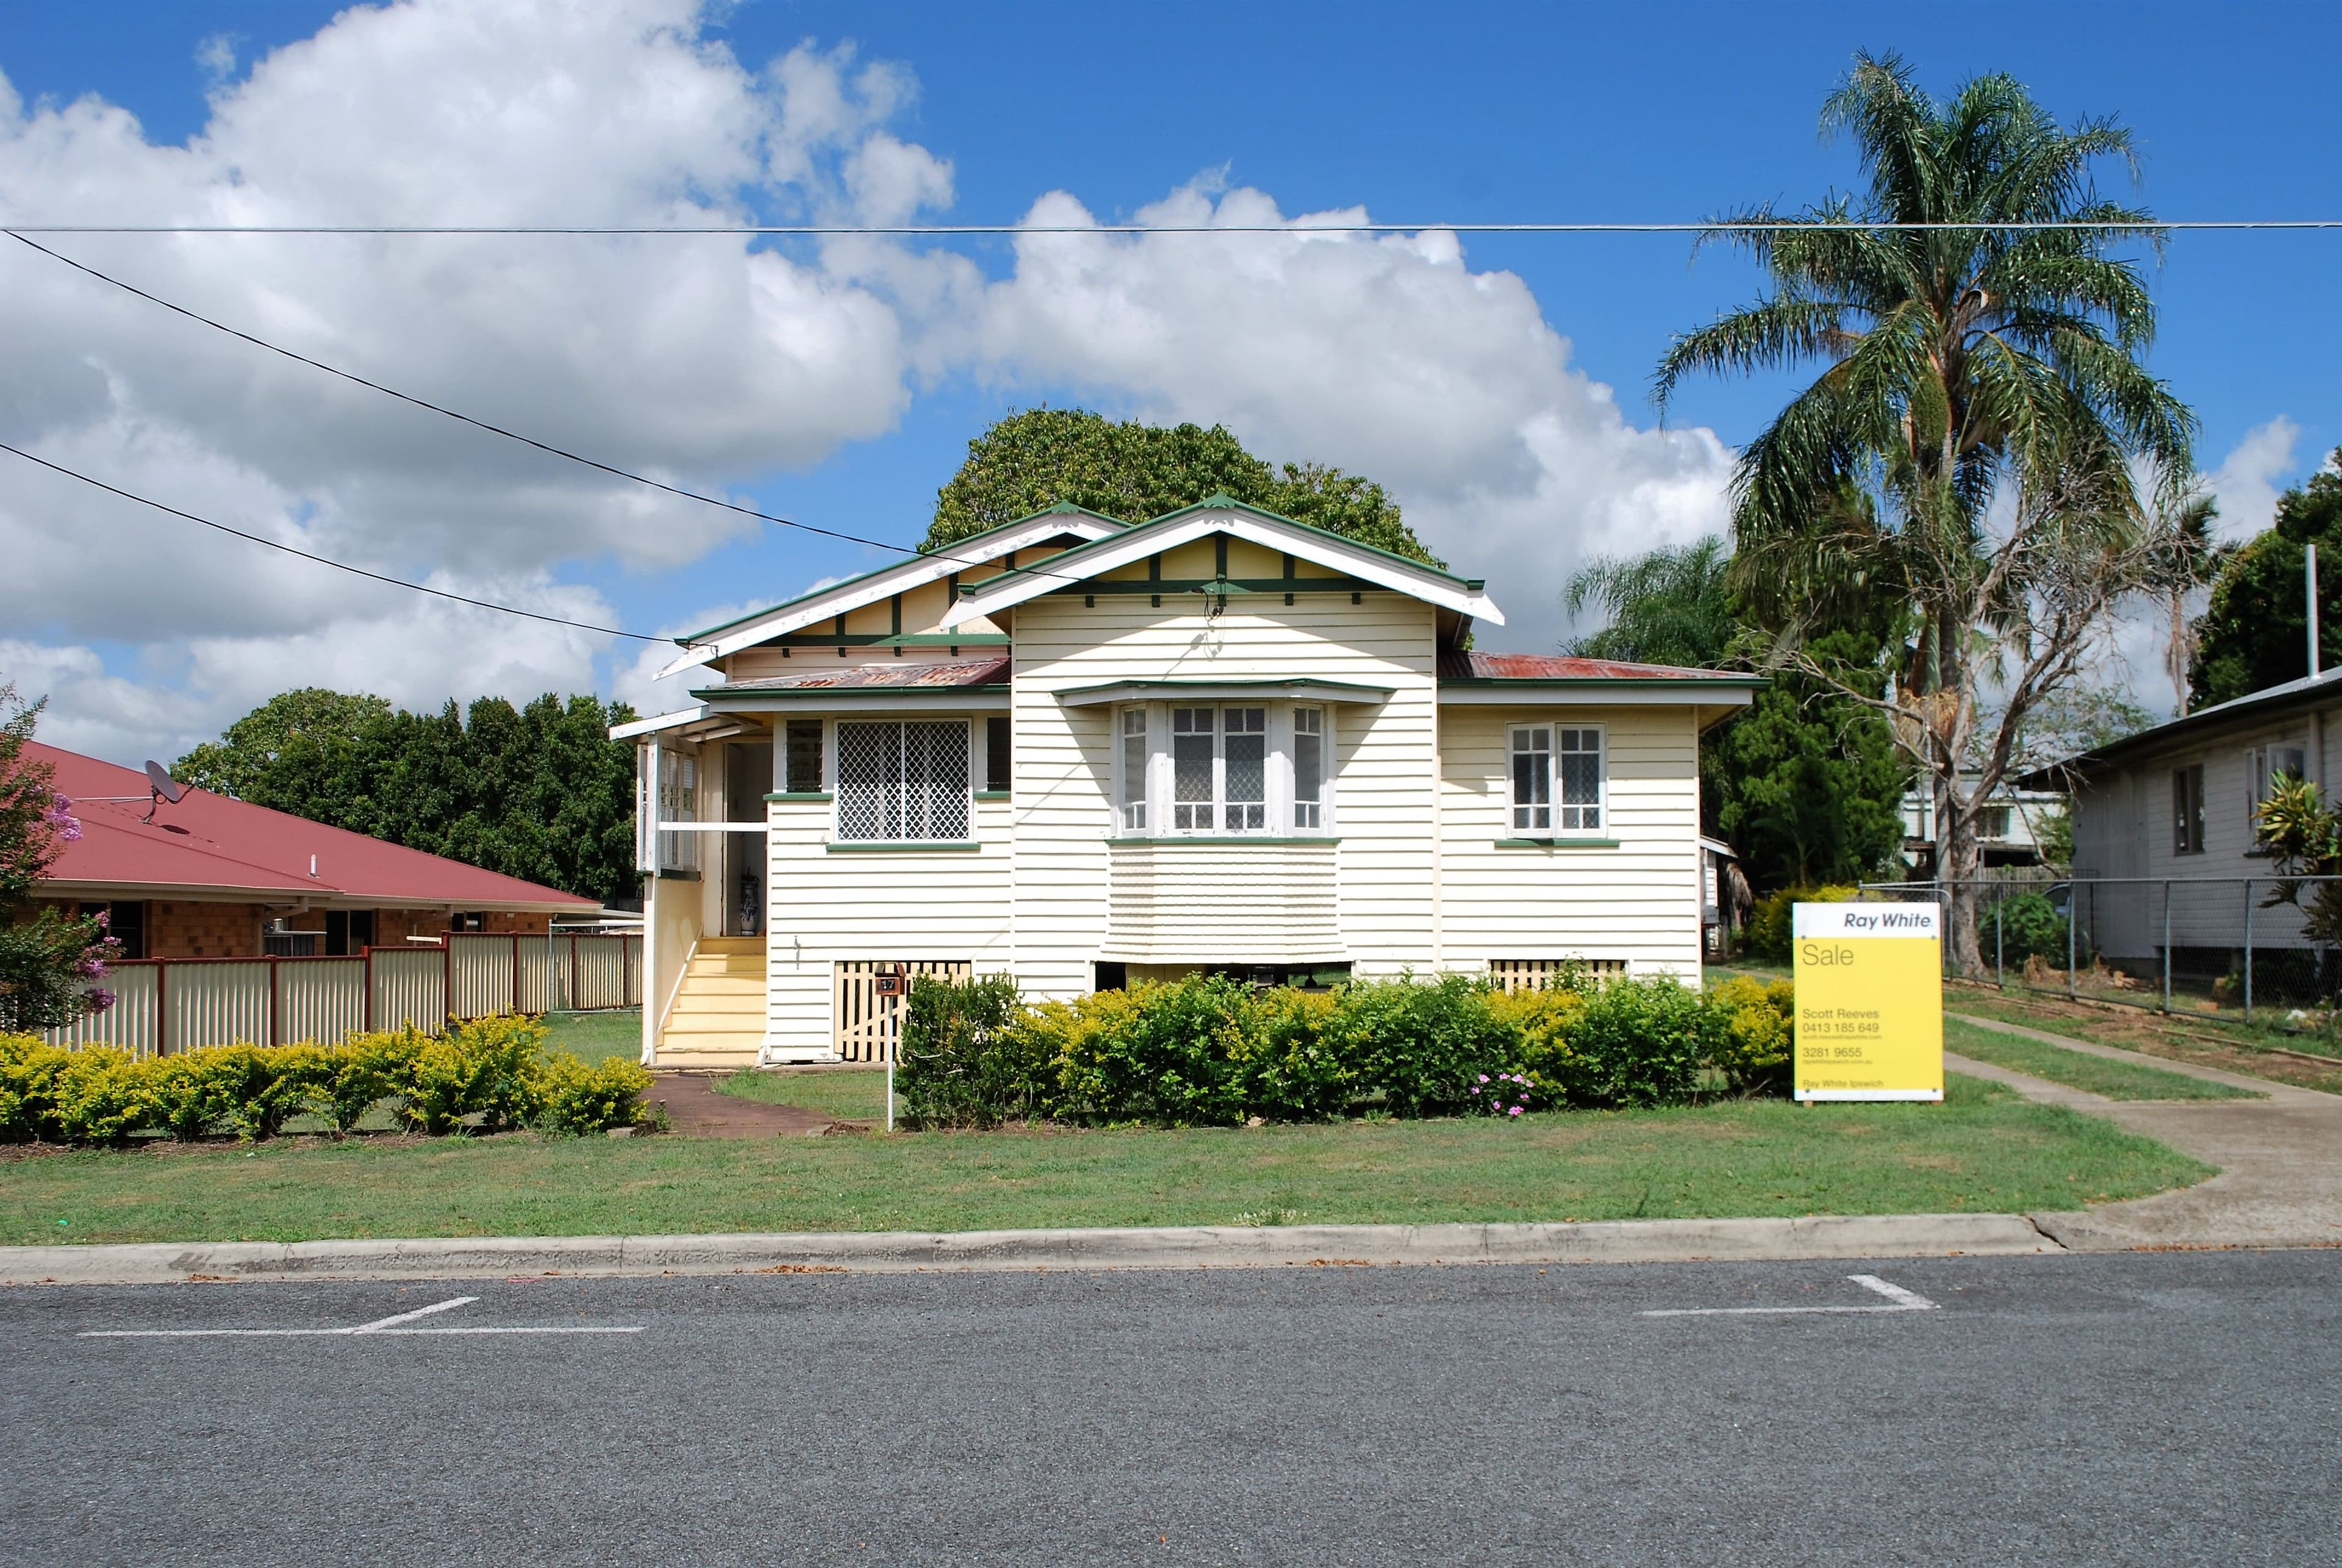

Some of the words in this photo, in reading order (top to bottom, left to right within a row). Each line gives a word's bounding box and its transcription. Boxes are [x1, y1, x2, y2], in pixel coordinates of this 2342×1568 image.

[1844, 913, 1878, 930] Ray
[1882, 913, 1932, 928] White
[1802, 944, 1854, 966] Sale
[881, 979, 895, 989] 17
[1803, 1009, 1833, 1018] Scott
[1838, 1009, 1879, 1018] Reeves
[1803, 1023, 1830, 1033] 0413
[1835, 1023, 1855, 1033] 185
[1858, 1023, 1879, 1033] 649
[1803, 1048, 1830, 1057] 3281
[1835, 1048, 1862, 1057] 9655
[1803, 1079, 1819, 1088] Ray
[1850, 1079, 1883, 1088] Ipswich
